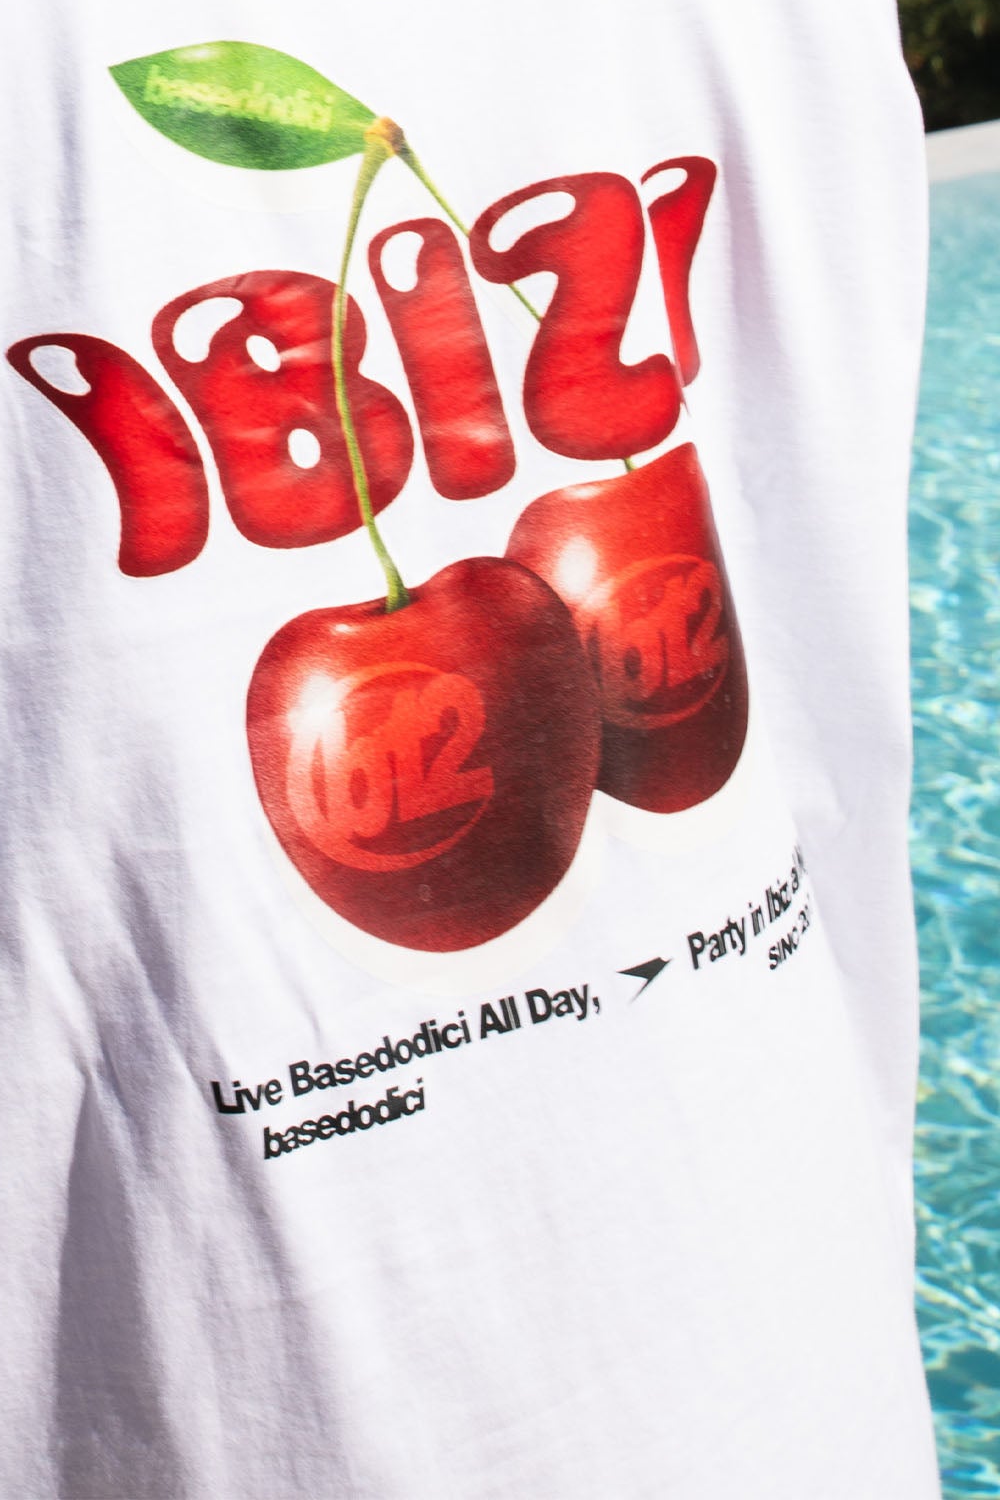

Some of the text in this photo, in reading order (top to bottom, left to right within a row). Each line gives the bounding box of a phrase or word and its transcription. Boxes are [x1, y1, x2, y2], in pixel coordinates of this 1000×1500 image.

[211, 1078, 282, 1115] Live
[288, 1010, 472, 1098] Basedodici
[479, 996, 521, 1040] All
[525, 983, 601, 1025] Day,
[687, 916, 746, 970] Party
[748, 902, 766, 937] in
[263, 1077, 427, 1160] basedodici
